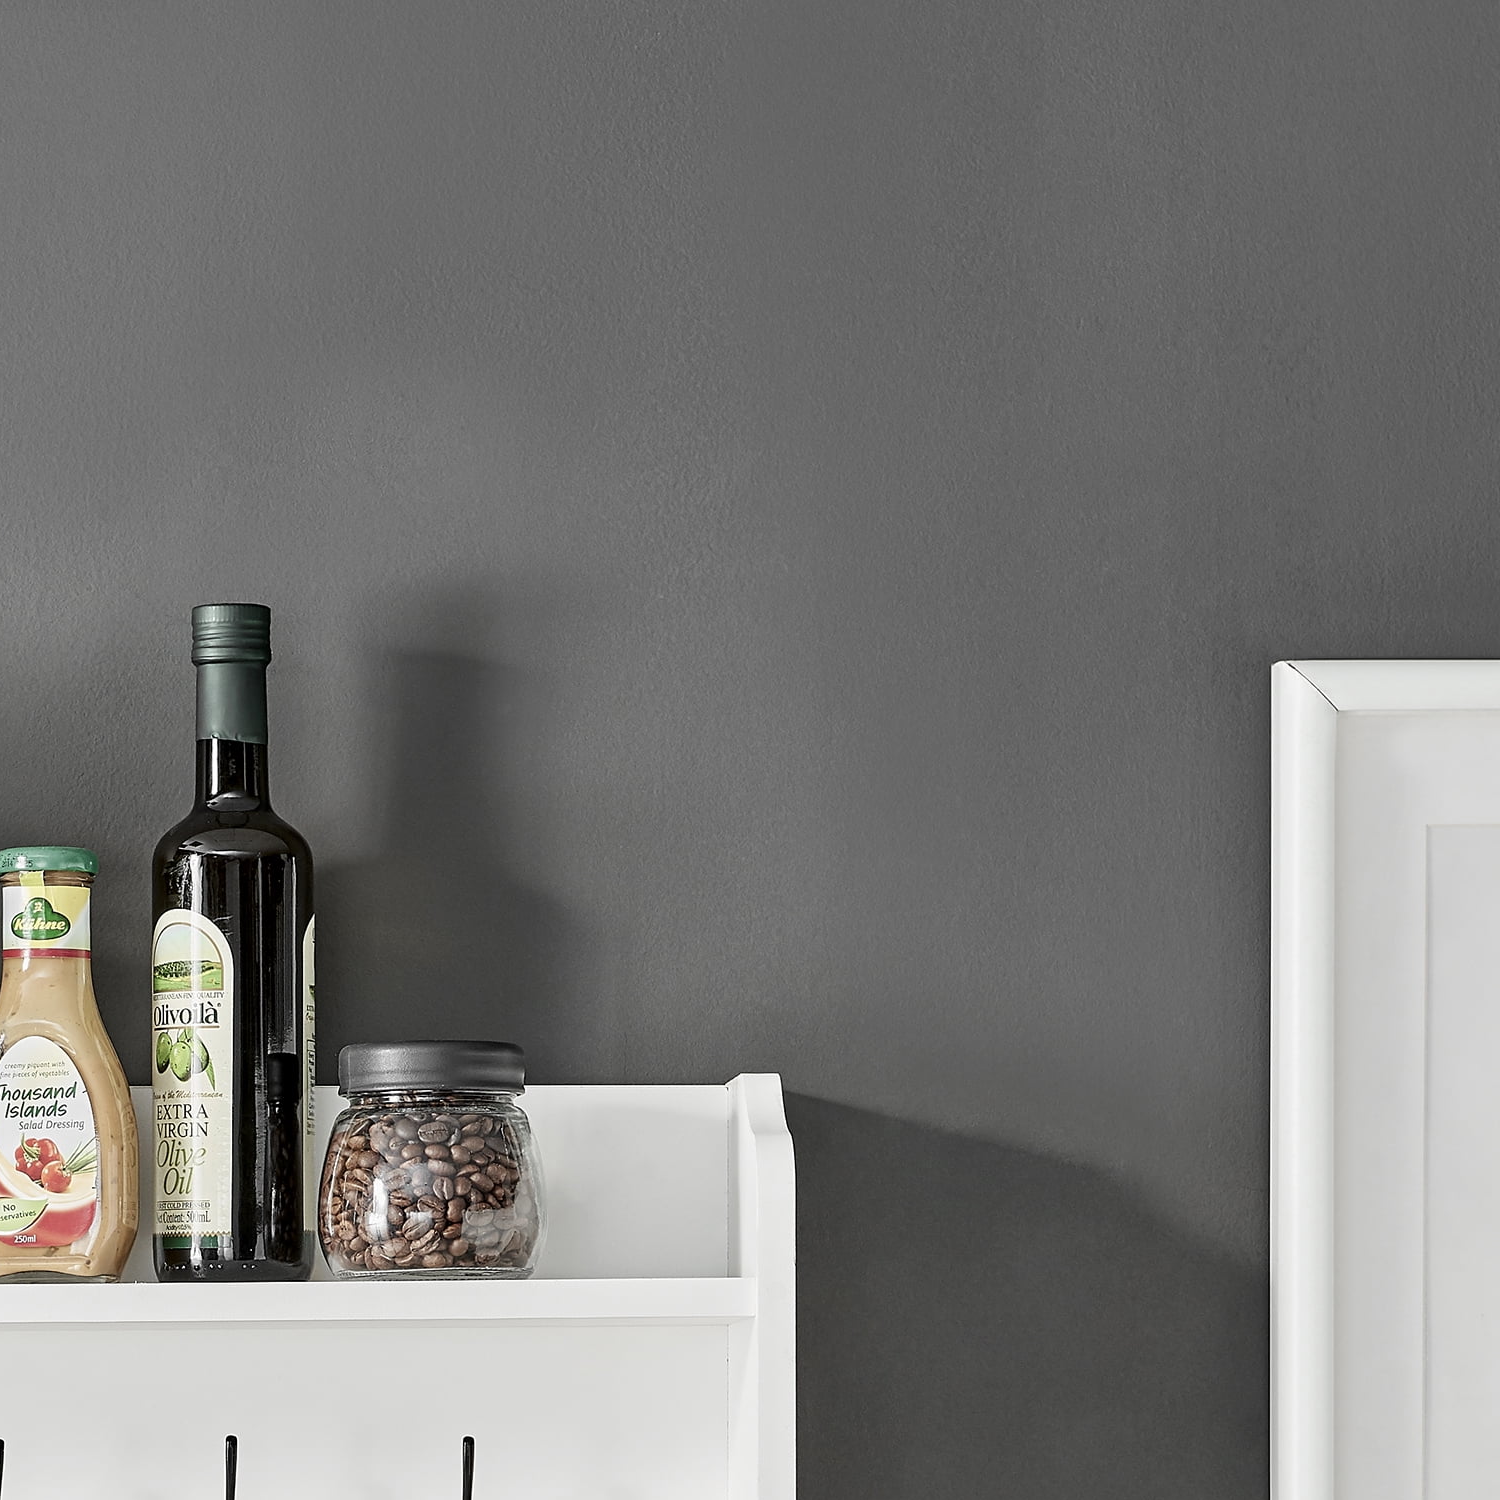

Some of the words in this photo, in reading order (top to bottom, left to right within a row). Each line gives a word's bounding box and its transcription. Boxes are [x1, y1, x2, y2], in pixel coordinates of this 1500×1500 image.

[196, 991, 225, 999] QUALITY
[153, 1001, 219, 1027] Olivoilà
[4, 1062, 26, 1071] creamy
[27, 1061, 50, 1070] piquant
[51, 1060, 66, 1068] with
[0, 1071, 11, 1080] fine
[12, 1071, 30, 1079] pieces
[31, 1070, 38, 1079] of
[39, 1069, 70, 1079] vegetables
[4, 1100, 68, 1119] Islands
[156, 1103, 209, 1120] EXTRA
[18, 1120, 43, 1131] Salad
[45, 1120, 85, 1131] Dressing
[156, 1121, 209, 1139] VIRGIN
[157, 1139, 207, 1168] Olive
[163, 1167, 193, 1195] Oil
[2, 1204, 17, 1212] No
[13, 1234, 37, 1244] 250ml
